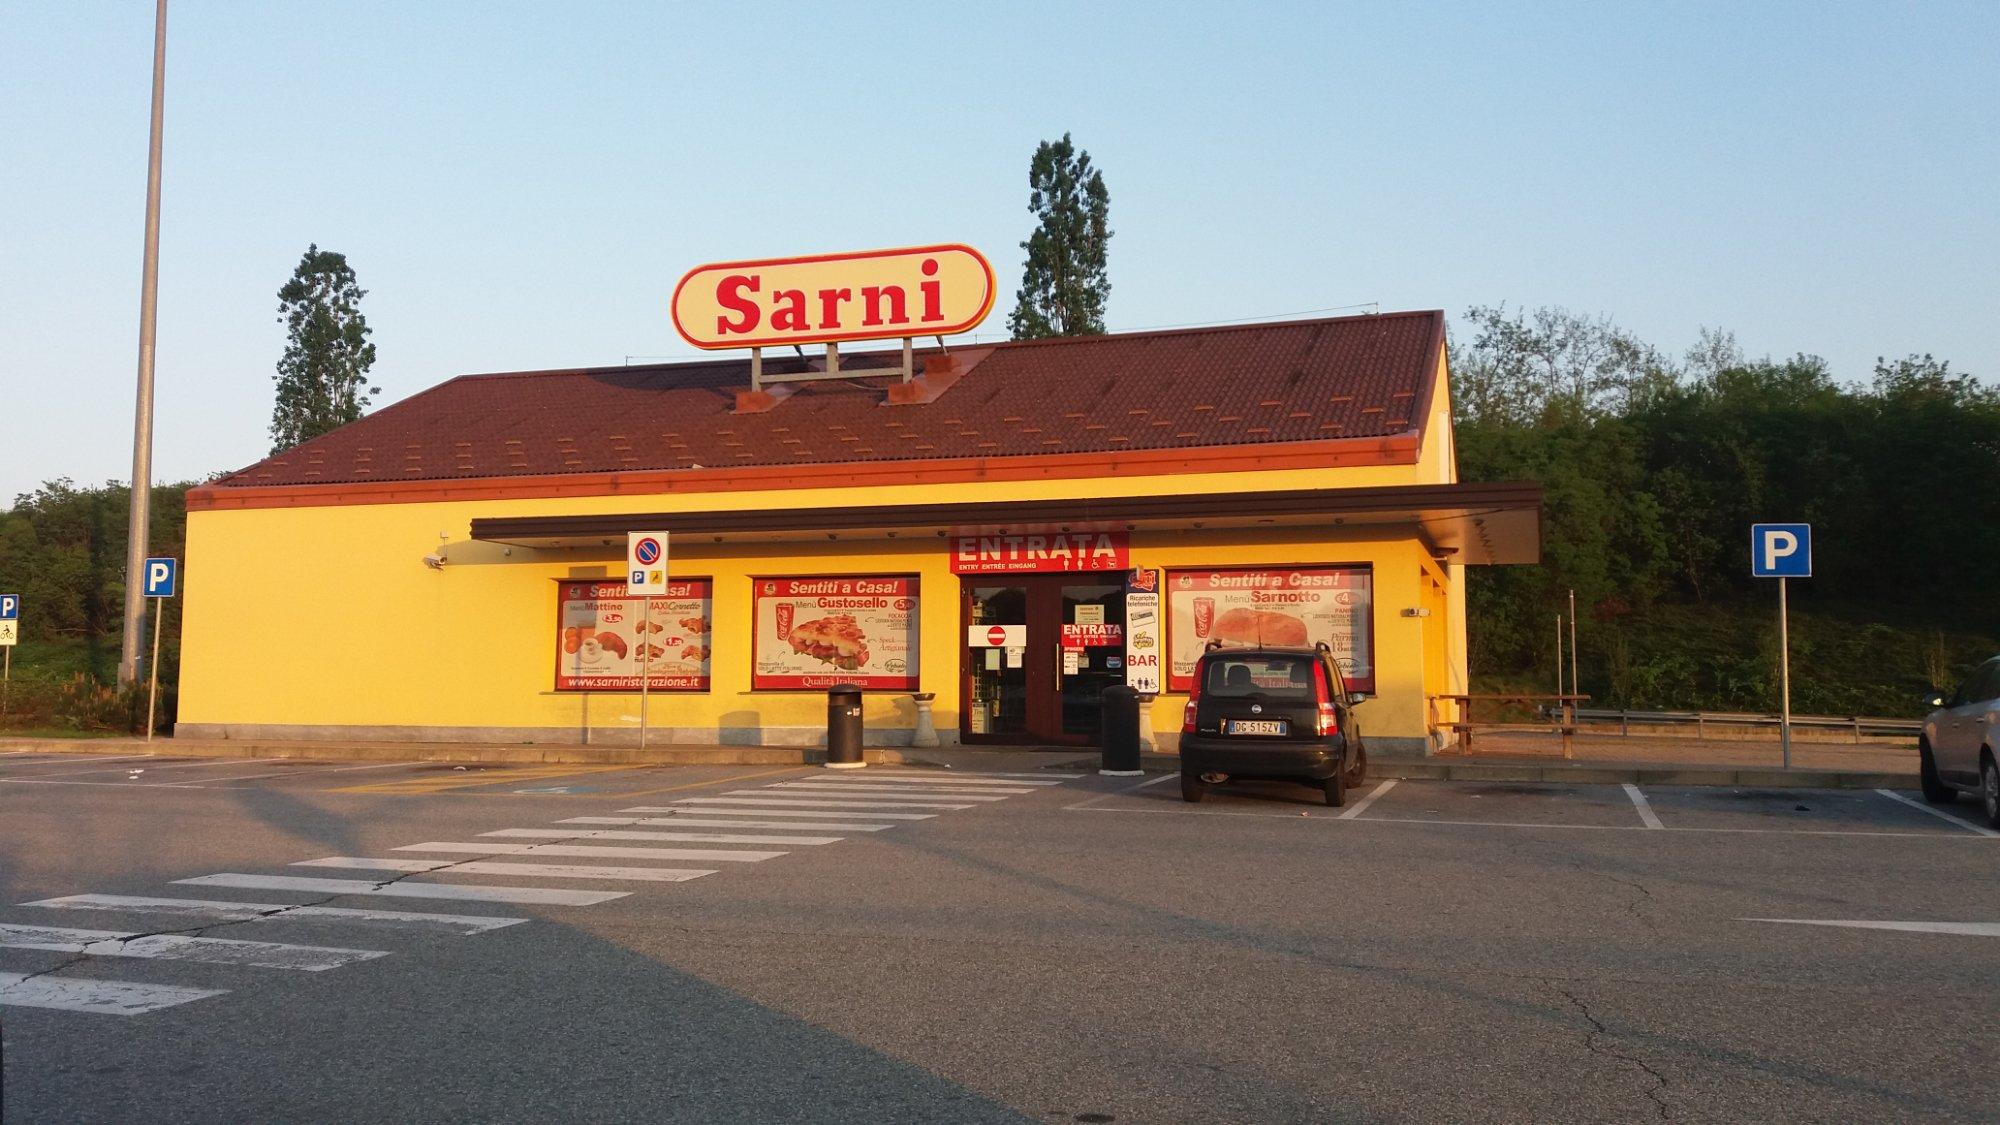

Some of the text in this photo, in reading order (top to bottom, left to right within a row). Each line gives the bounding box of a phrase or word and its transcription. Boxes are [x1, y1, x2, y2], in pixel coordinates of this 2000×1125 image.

[716, 258, 945, 335] Sarni
[958, 534, 1116, 561] ENTRATA
[1765, 531, 1798, 570] P
[149, 563, 169, 592] P
[634, 572, 643, 583] P
[1209, 572, 1340, 588] Sentiti a Casa!
[589, 585, 628, 598] Senti
[789, 581, 898, 594] Sentiti a Casa!
[817, 597, 888, 609] Gustosello
[1250, 590, 1321, 603] Sarnotto
[2, 597, 14, 617] P
[584, 602, 623, 611] Mattino
[1063, 625, 1122, 635] ENTRATA
[1128, 655, 1158, 667] BAR
[802, 676, 868, 687] Qualità Italiana
